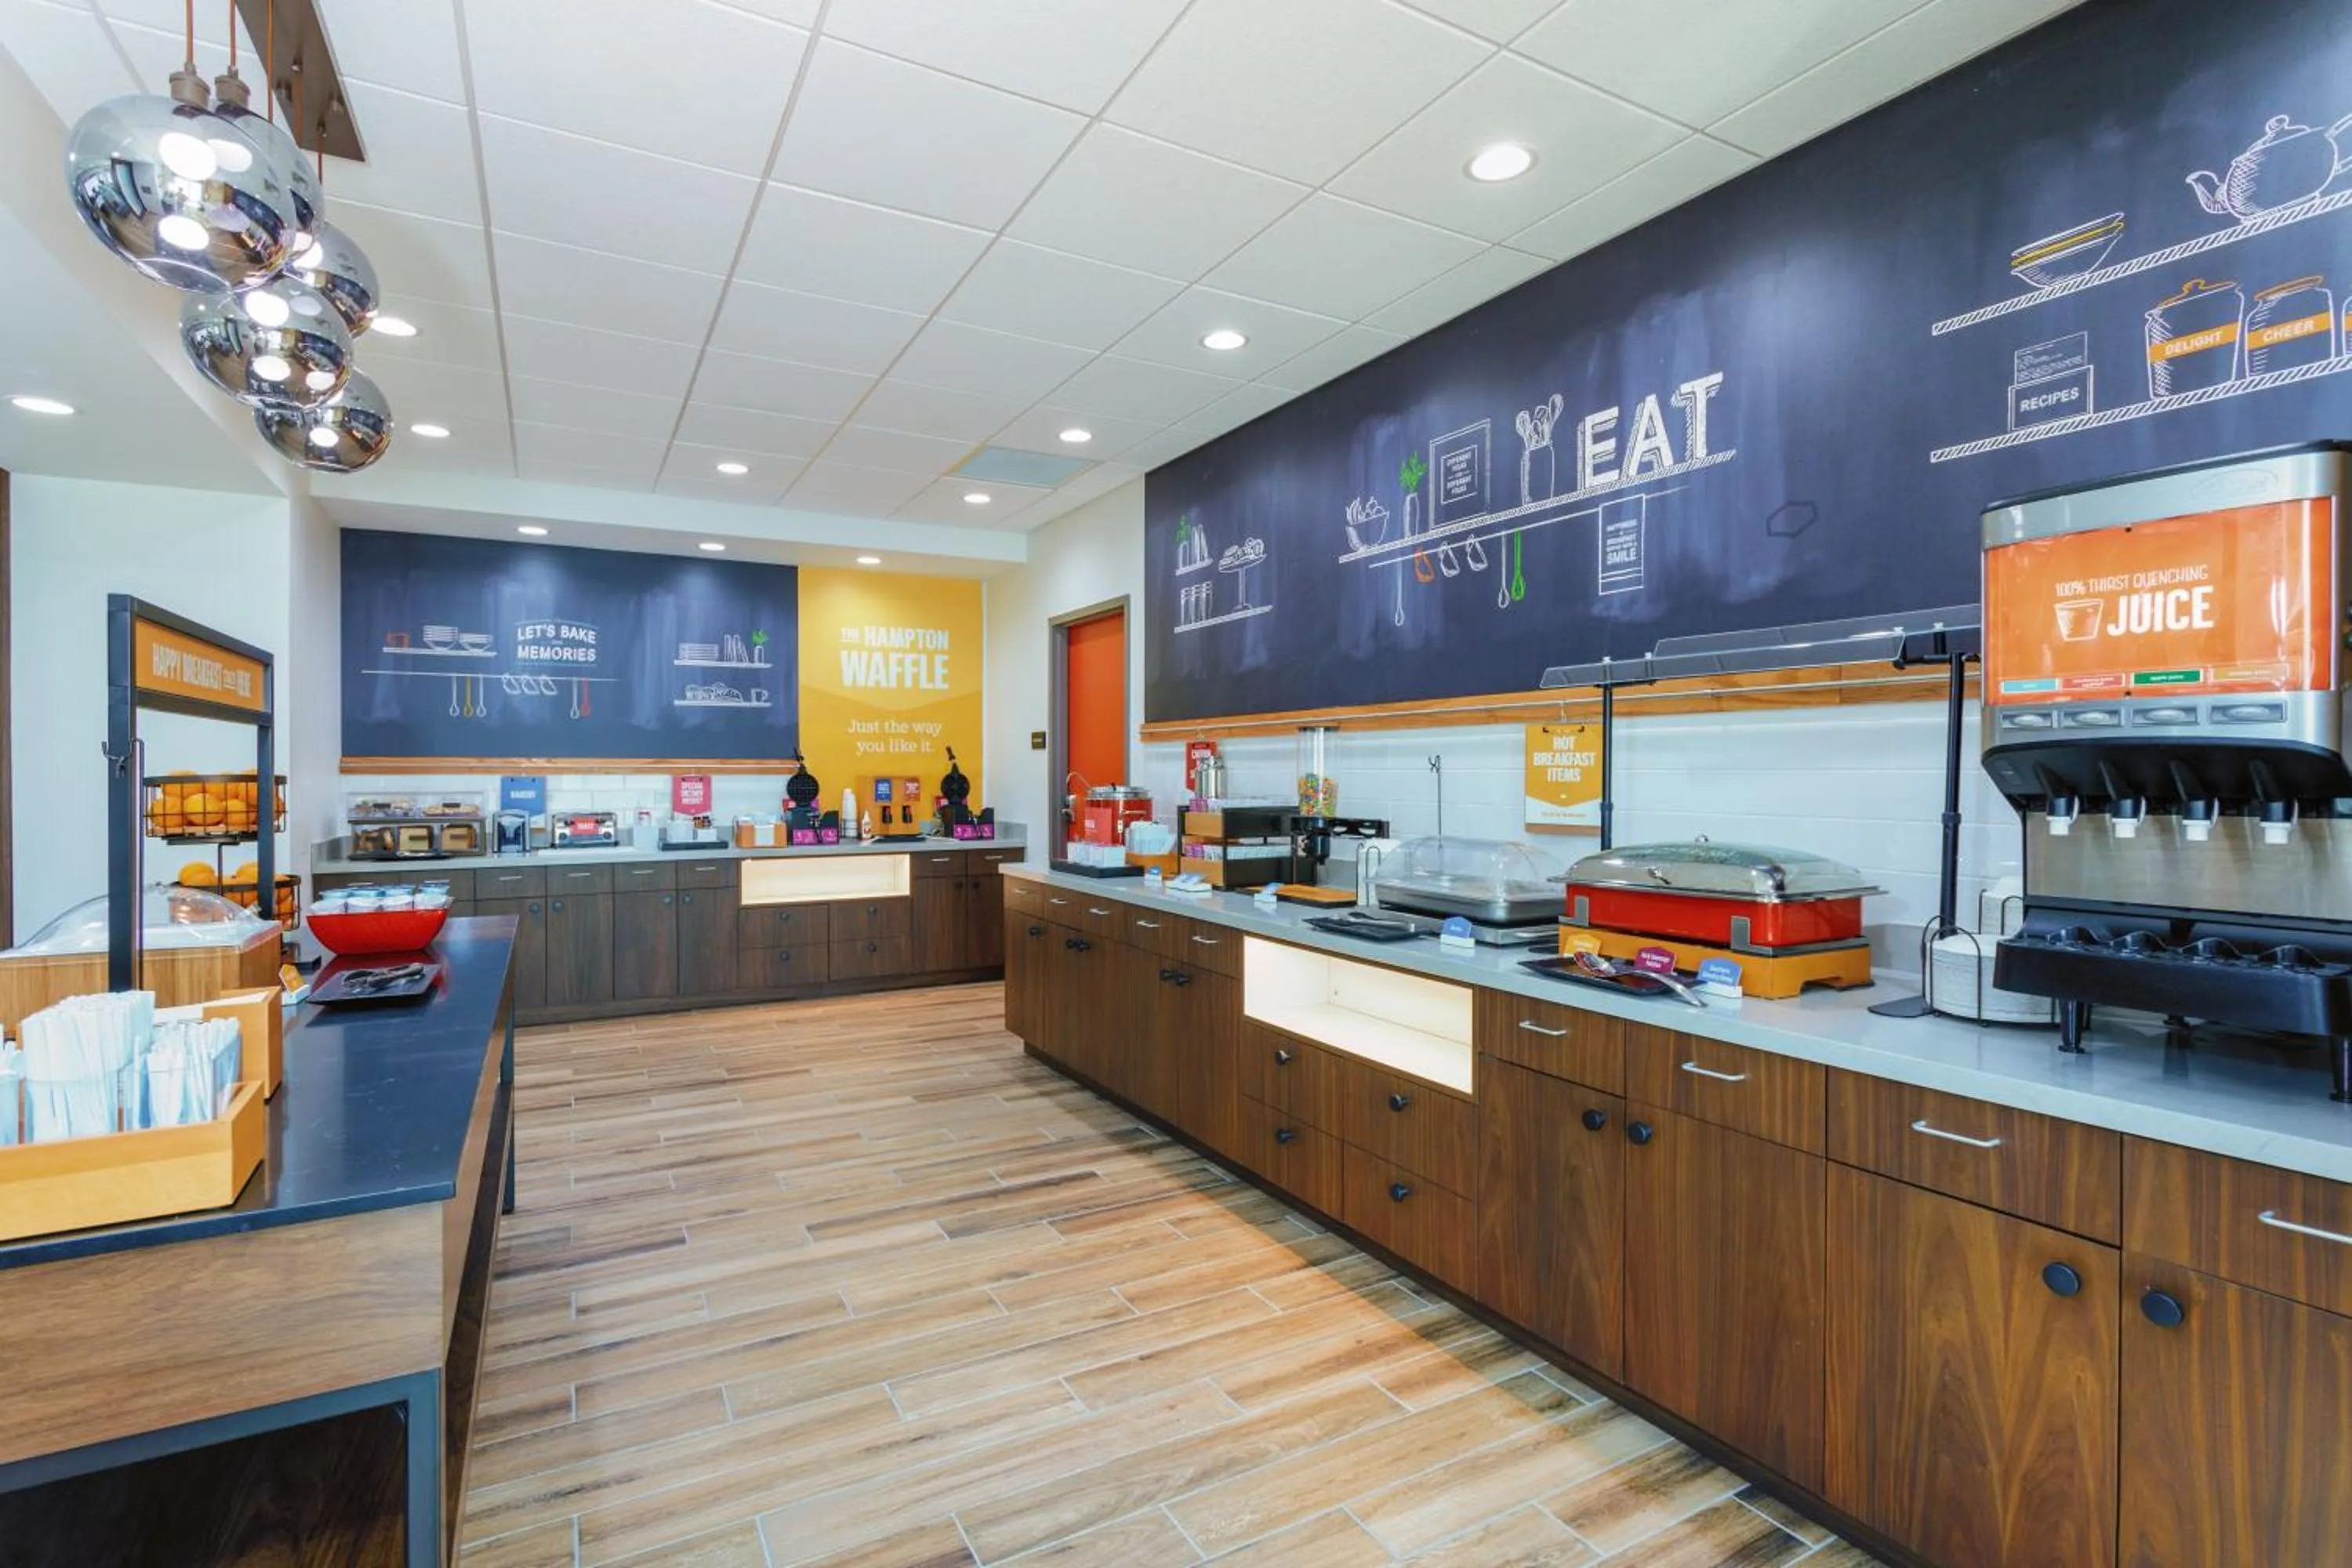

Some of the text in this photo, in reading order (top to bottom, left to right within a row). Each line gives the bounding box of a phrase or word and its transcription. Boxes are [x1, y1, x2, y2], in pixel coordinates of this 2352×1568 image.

[2165, 330, 2222, 355] DELIGHT
[2262, 320, 2314, 343] CHEER
[2020, 387, 2080, 412] RECIPES
[1577, 371, 1724, 491] EAT
[1606, 547, 1636, 565] SMILE
[2055, 564, 2209, 597] 100% THIRST QUENCHING
[2107, 585, 2215, 637] JUICE
[517, 624, 597, 644] LET'S BAKE
[865, 626, 949, 650] HAMPTON
[517, 645, 597, 662] MEMORIES
[153, 642, 181, 681] HAPPY
[183, 652, 223, 690] BREAKFAST
[840, 650, 949, 690] WAFFLE
[848, 719, 942, 738] Just the way
[856, 740, 885, 757] you
[890, 739, 917, 753] like
[1553, 735, 1576, 750] HOT
[1533, 752, 1596, 766] BREAKFAST
[1547, 768, 1581, 782] ITEMS
